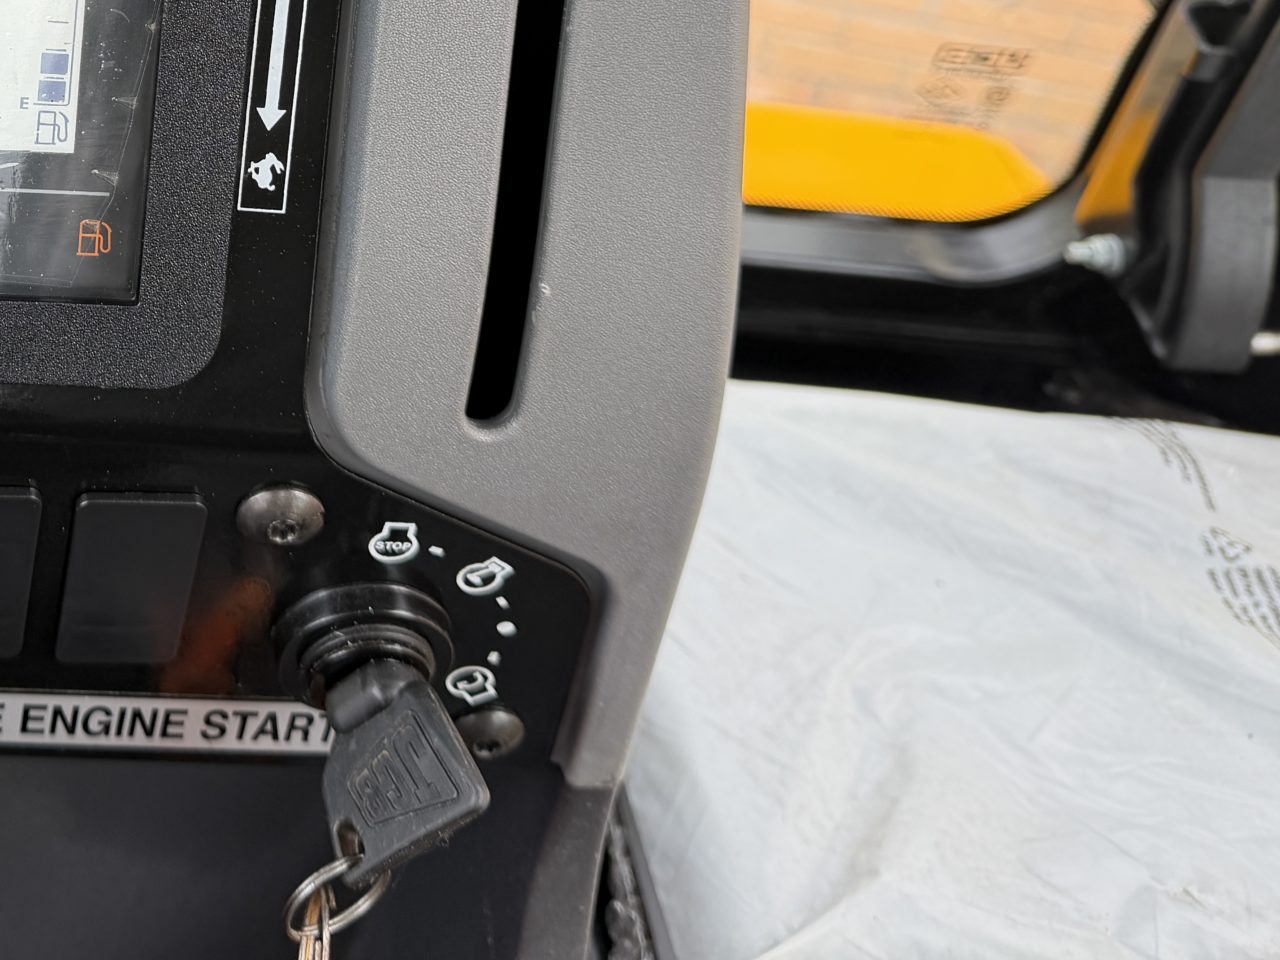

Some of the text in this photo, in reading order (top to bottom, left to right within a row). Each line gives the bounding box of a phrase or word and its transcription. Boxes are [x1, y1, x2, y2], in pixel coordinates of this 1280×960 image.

[20, 97, 30, 110] E
[375, 540, 413, 554] STOP
[20, 703, 189, 739] ENGINE
